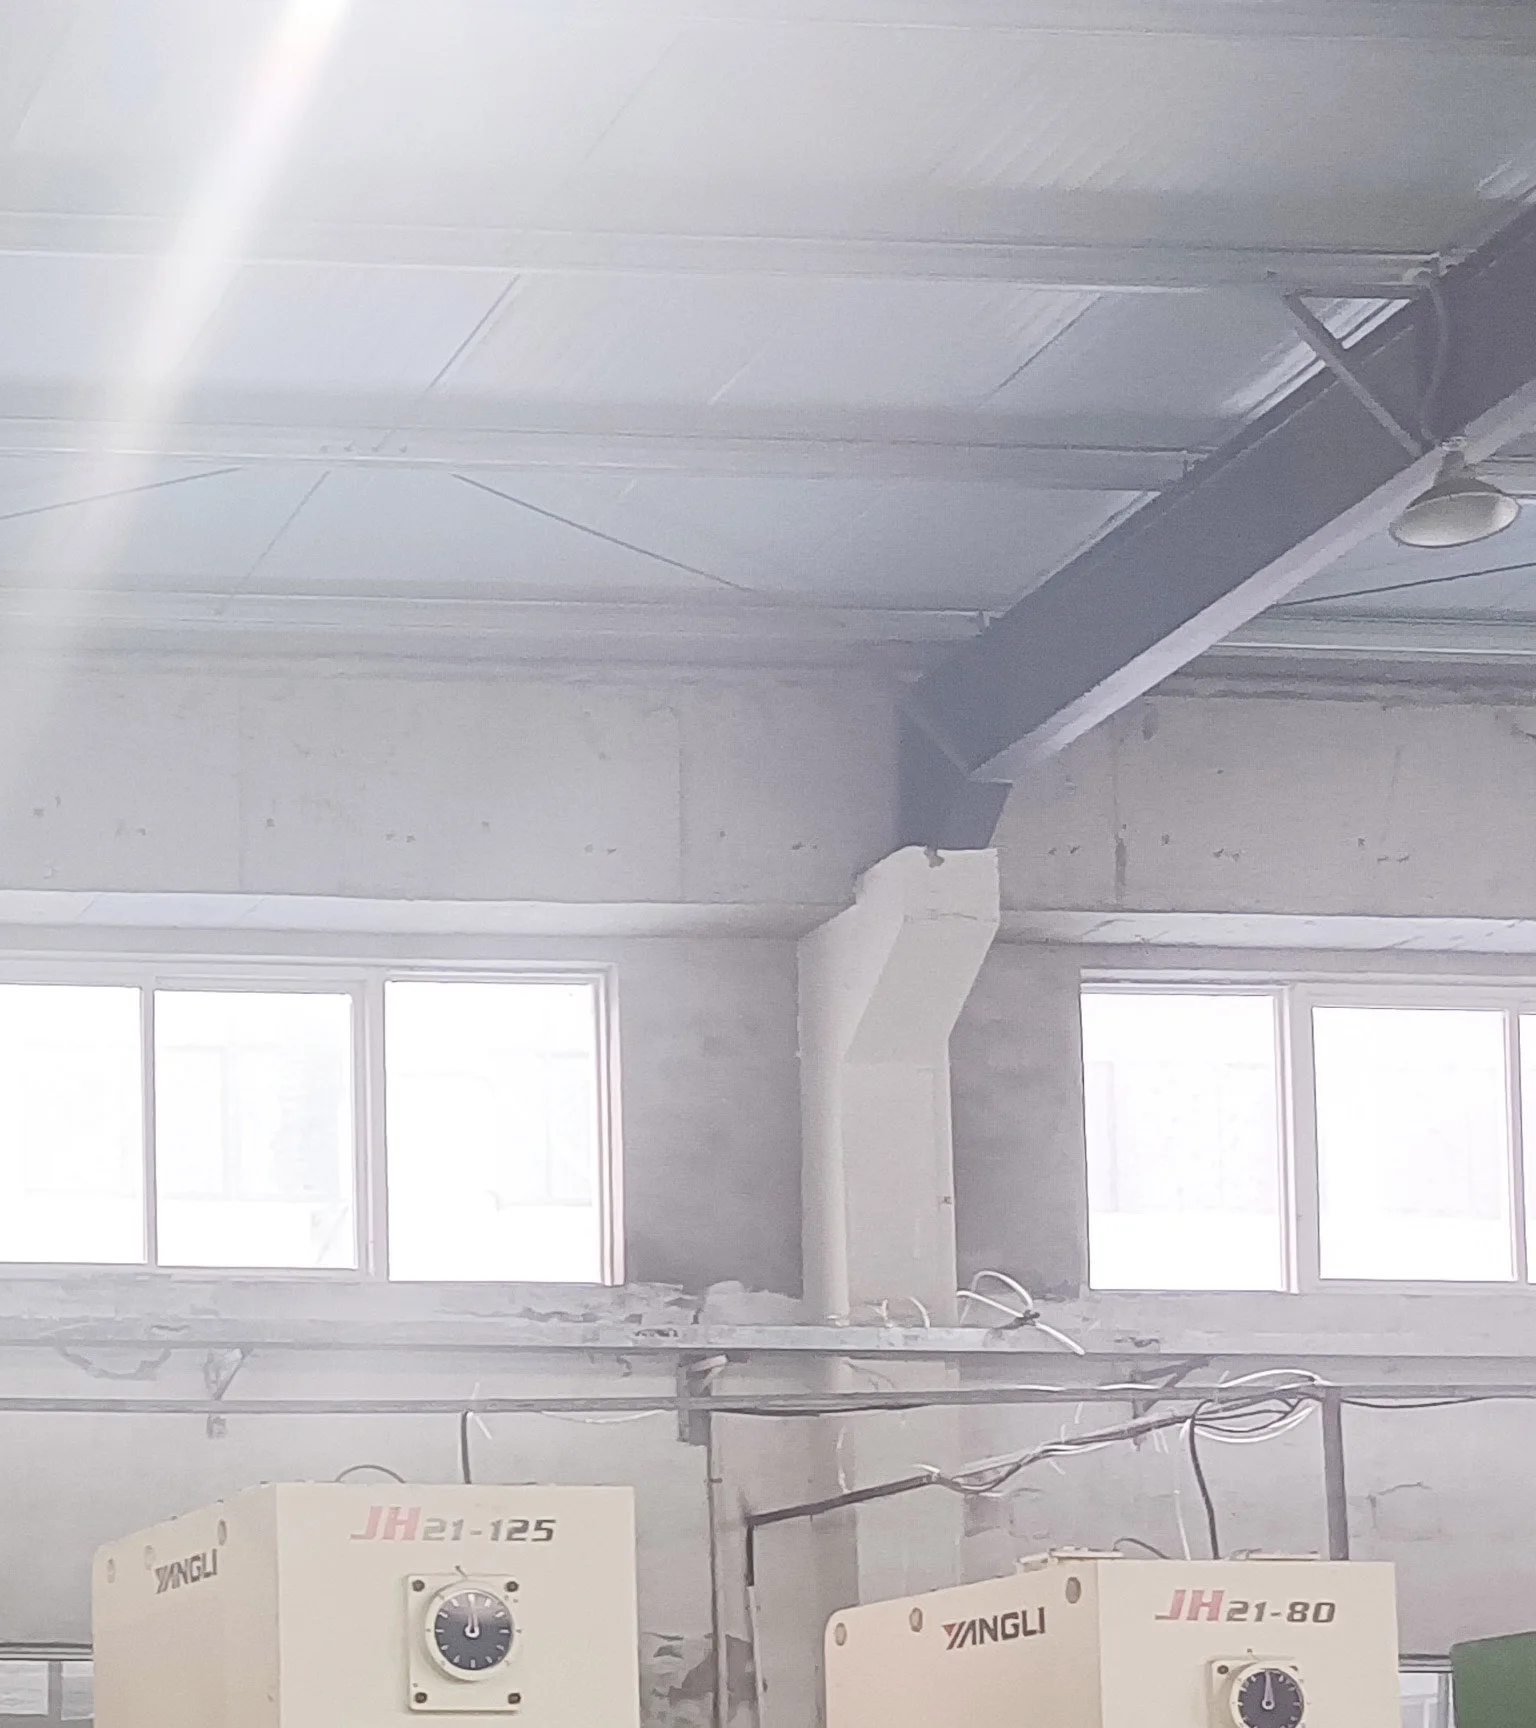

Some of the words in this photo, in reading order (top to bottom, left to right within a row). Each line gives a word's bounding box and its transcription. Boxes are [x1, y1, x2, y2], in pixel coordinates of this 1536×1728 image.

[350, 1505, 557, 1543] JH21-125
[154, 1547, 219, 1595] YANGLI
[1154, 1588, 1337, 1624] JH21-80
[940, 1606, 1047, 1651] YANGLI
